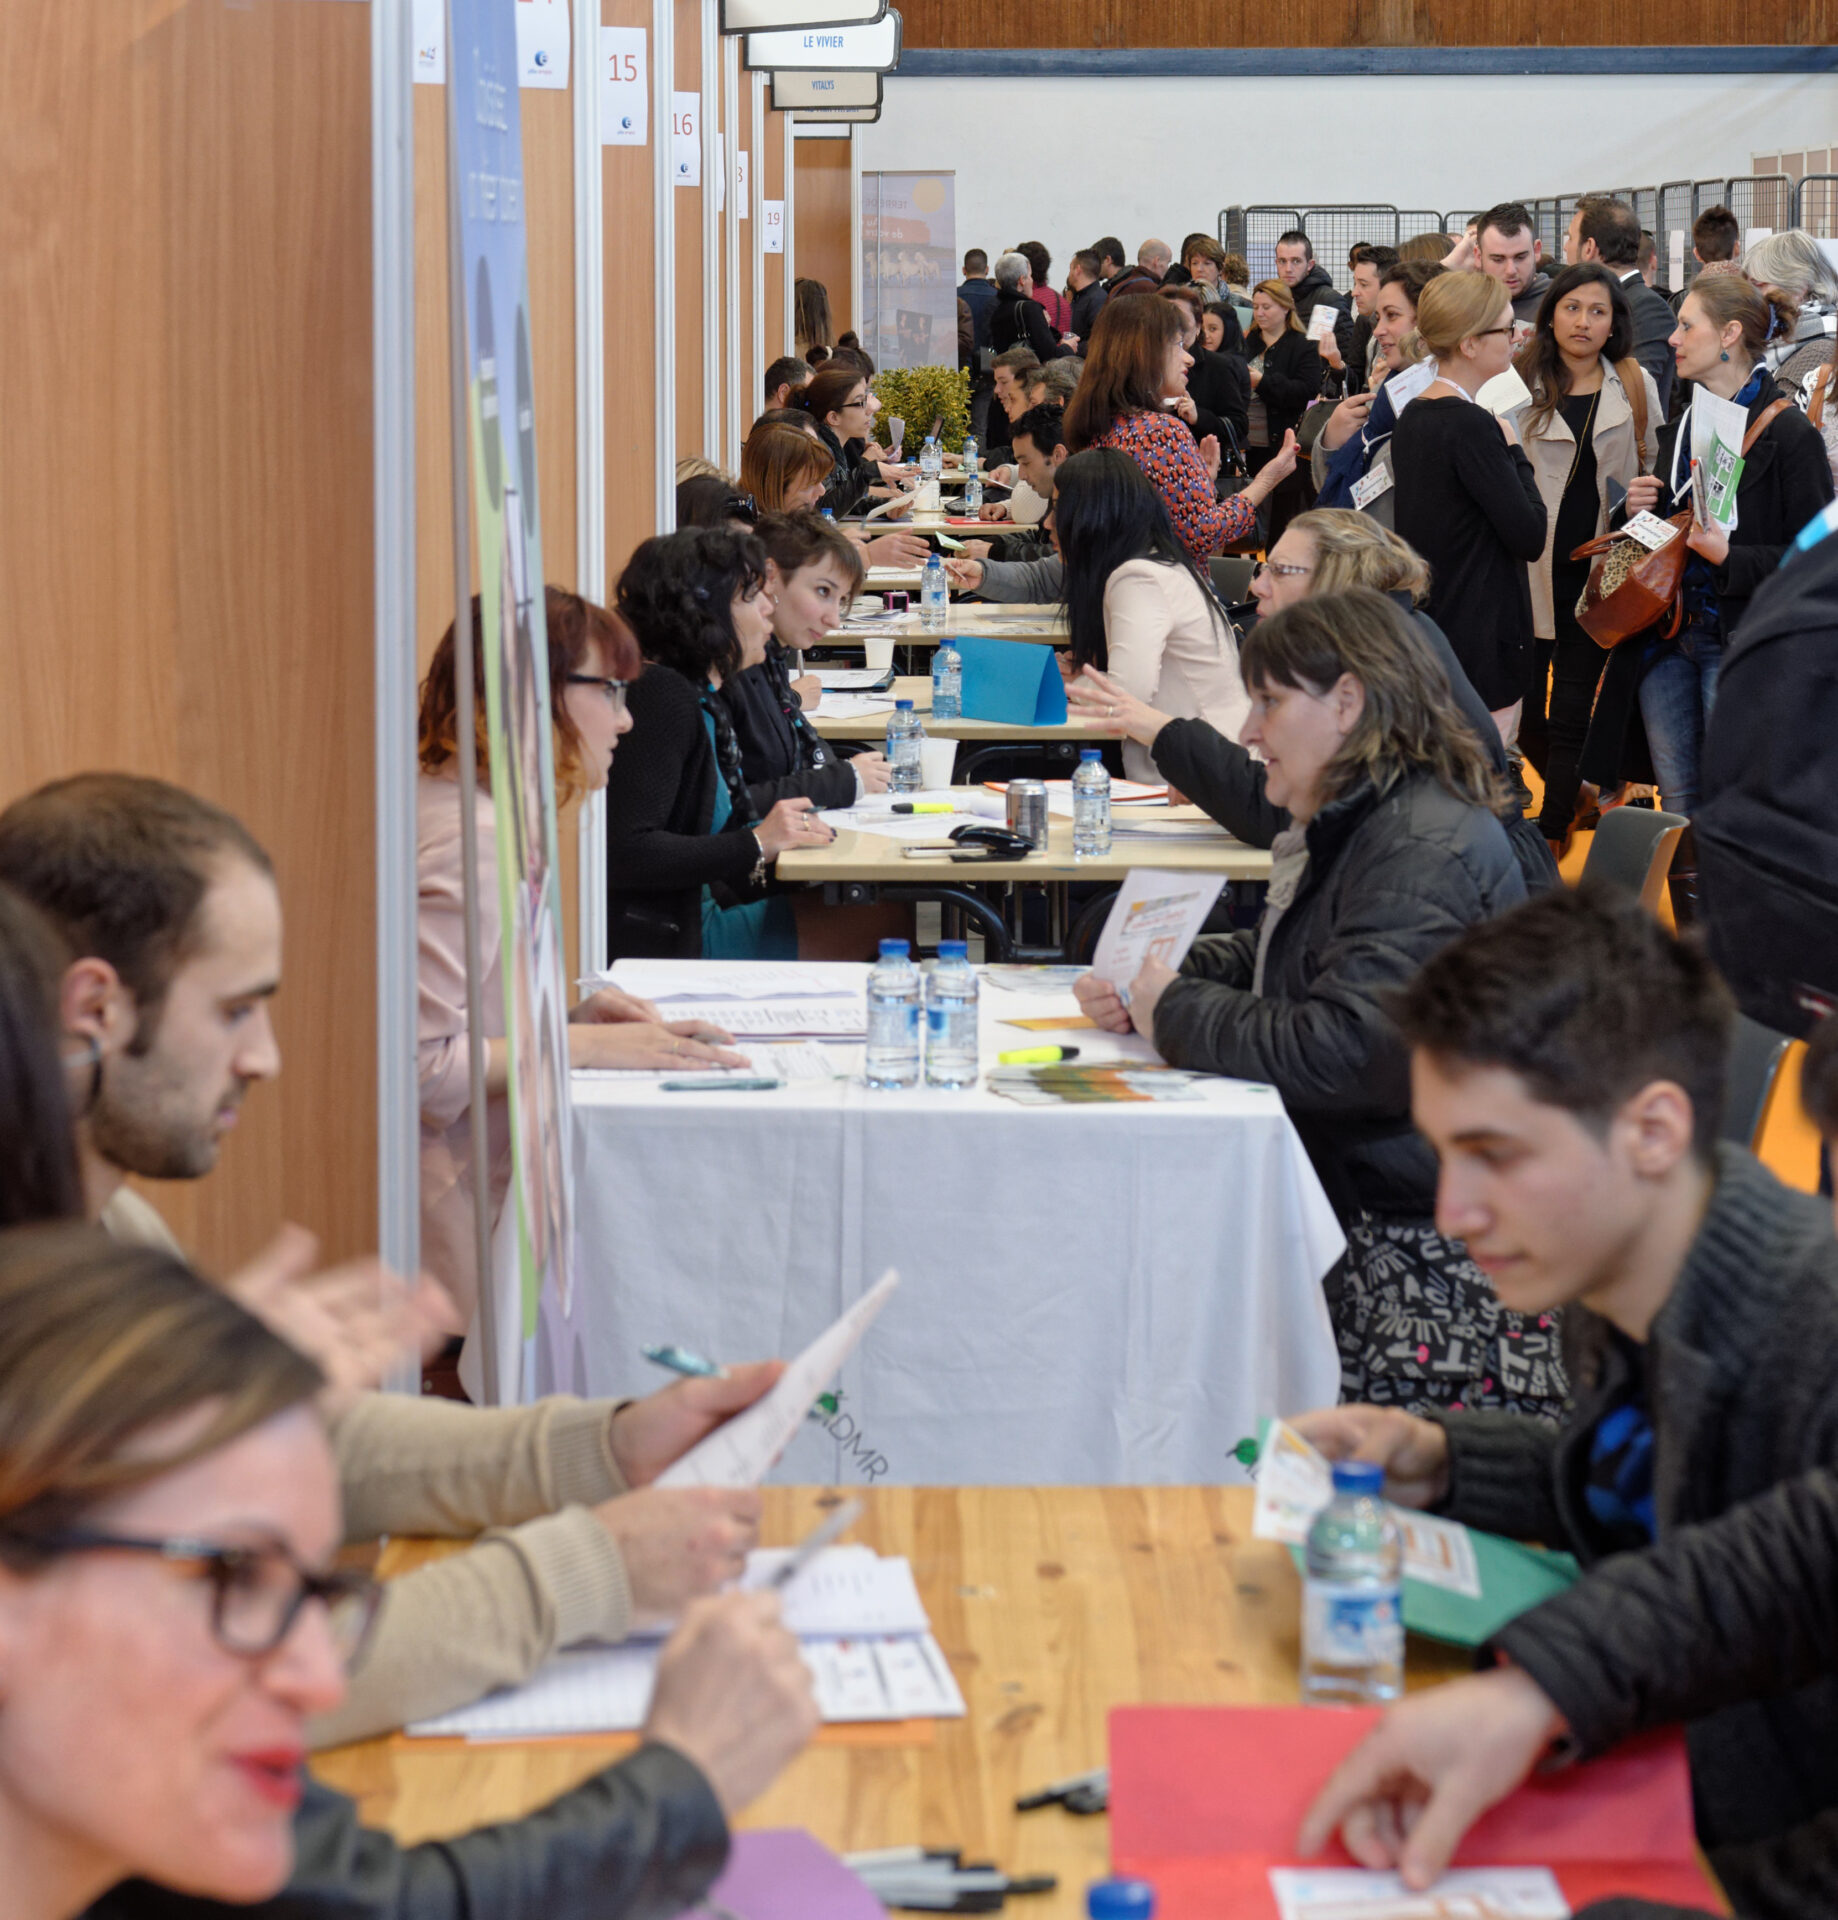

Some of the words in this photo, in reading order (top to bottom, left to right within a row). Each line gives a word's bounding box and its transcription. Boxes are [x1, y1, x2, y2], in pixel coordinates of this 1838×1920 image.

[803, 35, 814, 48] LE
[816, 35, 844, 48] VIVIER
[609, 54, 637, 82] 15
[811, 80, 835, 91] VITALYS
[673, 113, 693, 136] 16
[767, 212, 780, 225] 19
[822, 1412, 889, 1484] DMR
